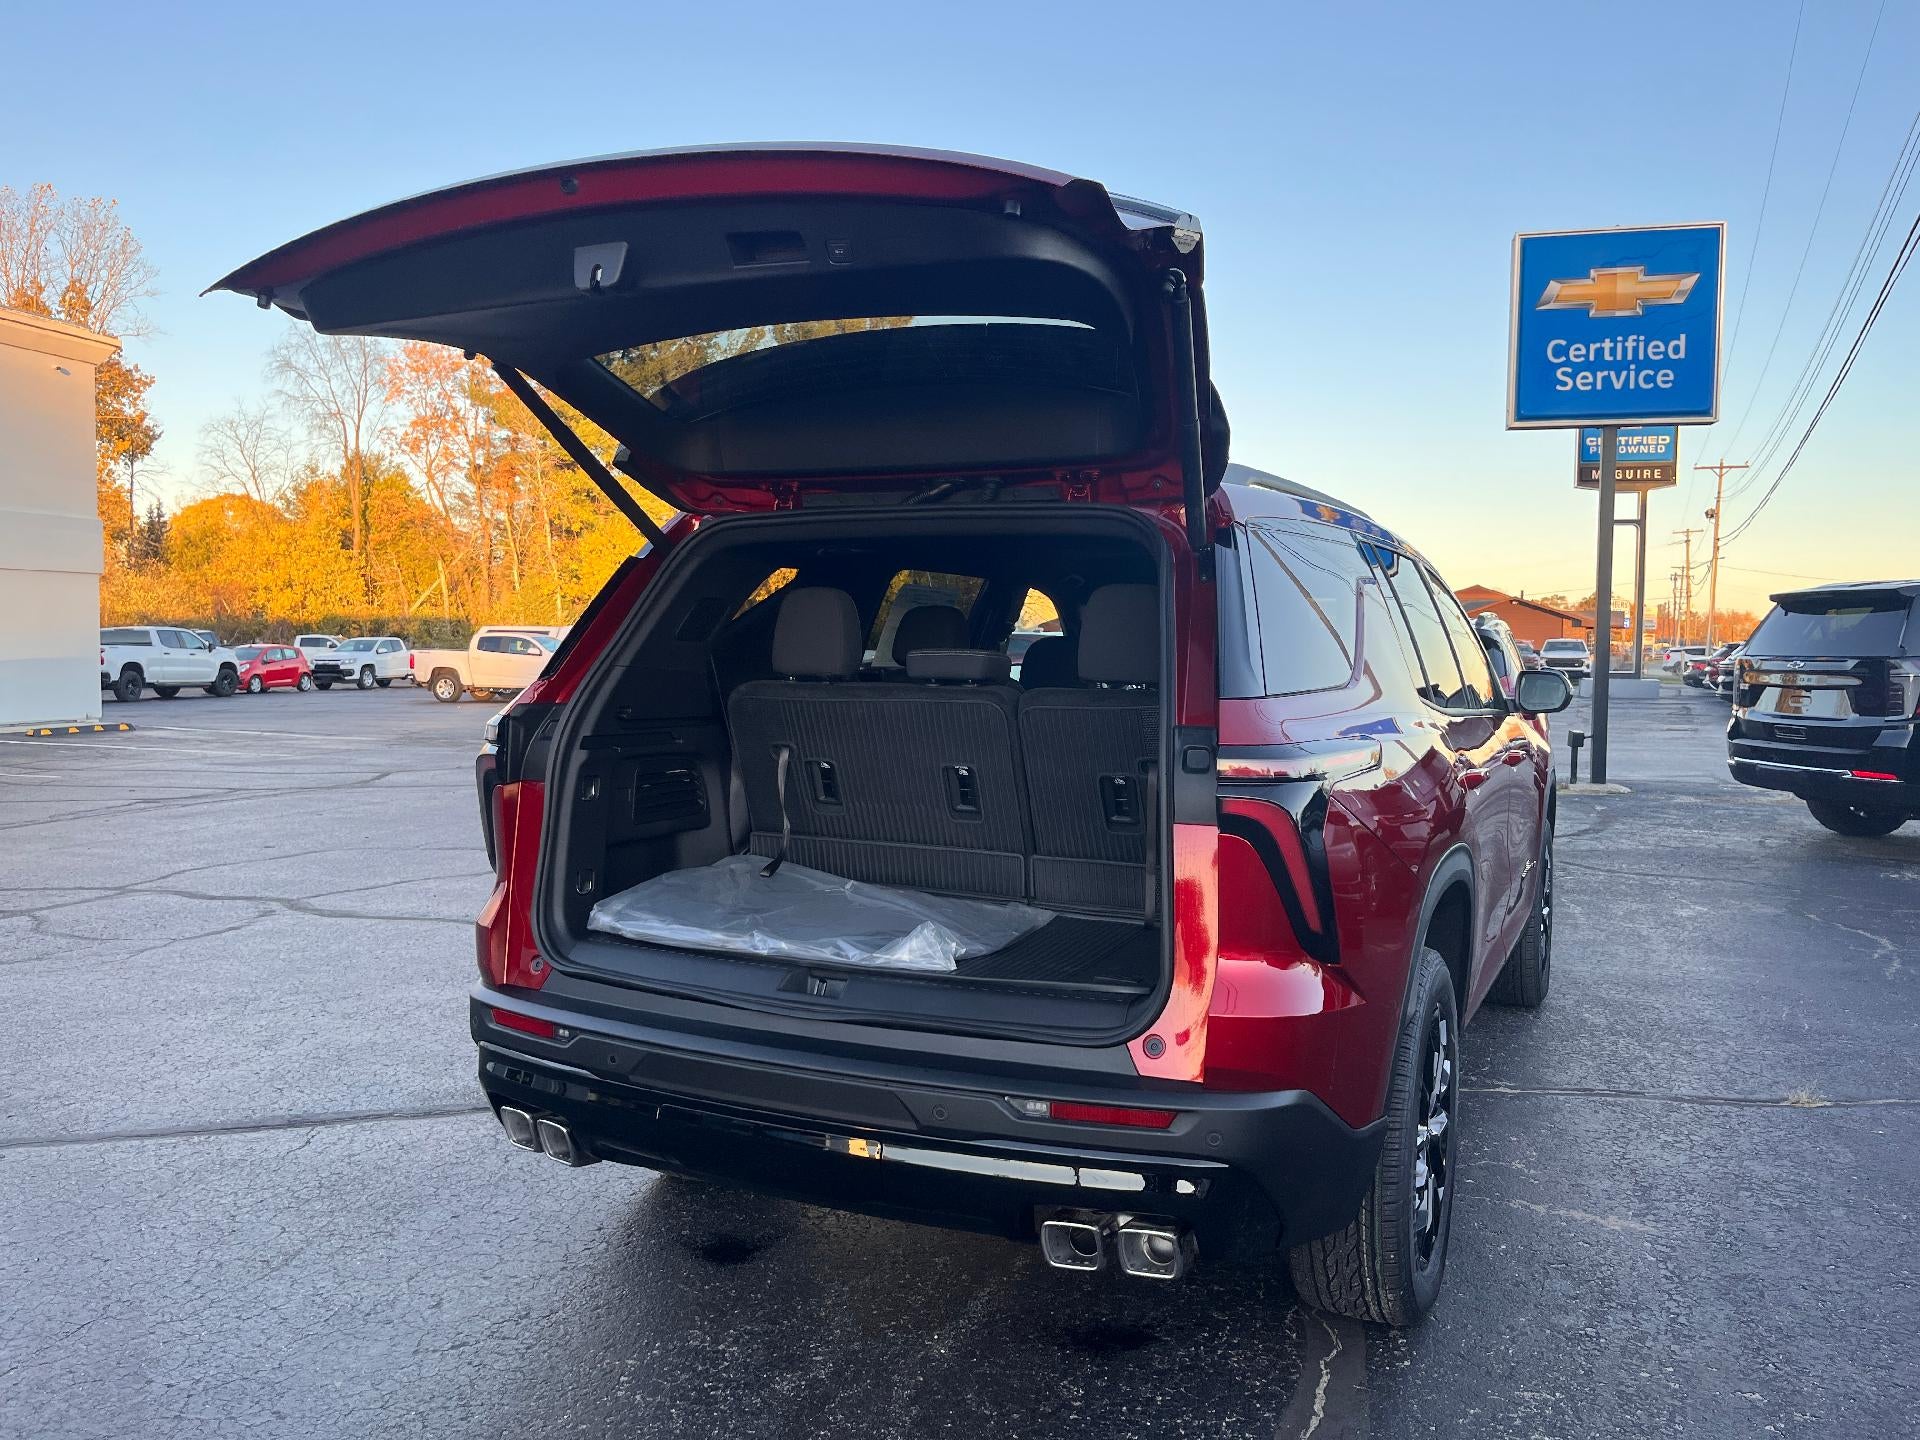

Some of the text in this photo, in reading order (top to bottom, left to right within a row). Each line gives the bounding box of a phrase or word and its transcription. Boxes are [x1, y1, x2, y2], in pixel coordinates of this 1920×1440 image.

[1546, 333, 1687, 364] Certified
[1555, 363, 1676, 392] Service
[1586, 435, 1671, 446] CTIFIED
[1591, 468, 1662, 480] MGUIRE
